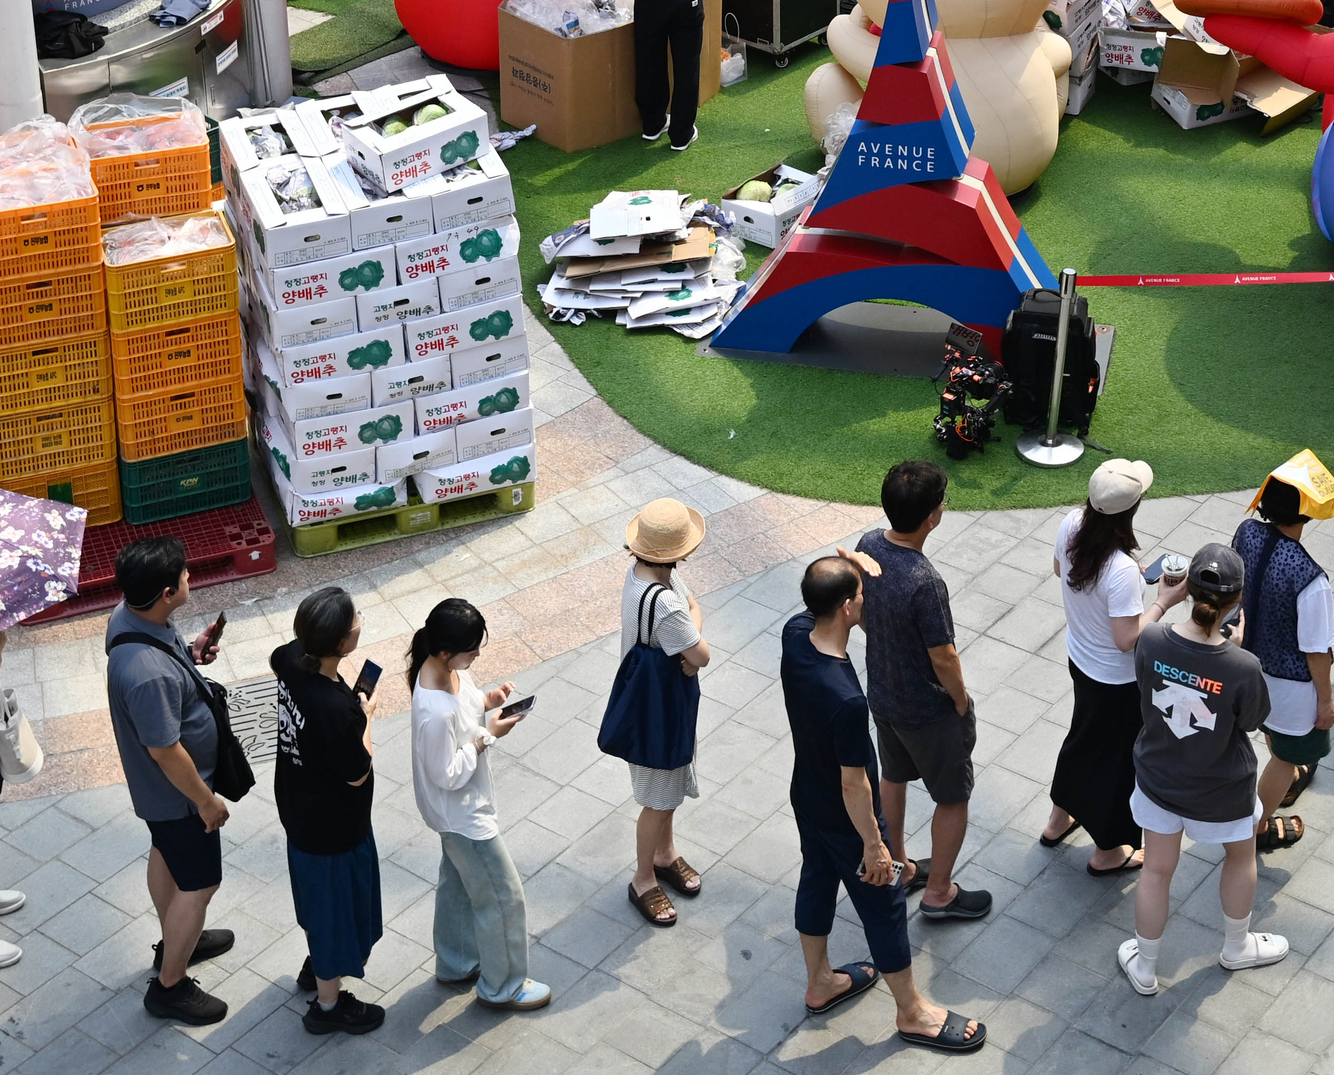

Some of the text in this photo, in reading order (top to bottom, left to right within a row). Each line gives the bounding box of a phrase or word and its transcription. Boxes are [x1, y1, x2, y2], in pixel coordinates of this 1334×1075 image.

[1105, 43, 1135, 54] 청정고랭지
[1104, 50, 1135, 66] 양배추
[857, 141, 937, 159] AVENUE
[392, 148, 431, 170] 청정고랭지
[857, 155, 936, 174] FRANCE
[390, 160, 433, 186] 양배추
[30, 236, 49, 246] 진부농협
[406, 244, 449, 263] 청정고랭지
[405, 255, 451, 280] 양배추
[284, 272, 329, 288] 청정고랭지
[281, 281, 329, 305] 양배추
[395, 304, 435, 320] 양배추
[416, 323, 460, 341] 청정고랭지
[414, 335, 460, 357] 양배추
[292, 352, 337, 368] 청정고랭지
[290, 363, 338, 385] 양배추
[409, 379, 448, 396] 양배추
[425, 400, 468, 417] 청정고랭지
[423, 412, 468, 431] 양배추
[304, 424, 348, 440] 청정고랭지
[301, 436, 348, 457] 양배추
[178, 476, 200, 487] KPN
[332, 471, 371, 487] 양배추
[437, 470, 481, 486] 청정고랭지
[1311, 472, 1330, 488] SAVE
[434, 481, 479, 500] 양배추
[301, 496, 345, 508] 청정고랭지
[298, 506, 343, 522] 양배추
[1153, 660, 1224, 695] DESCENTE
